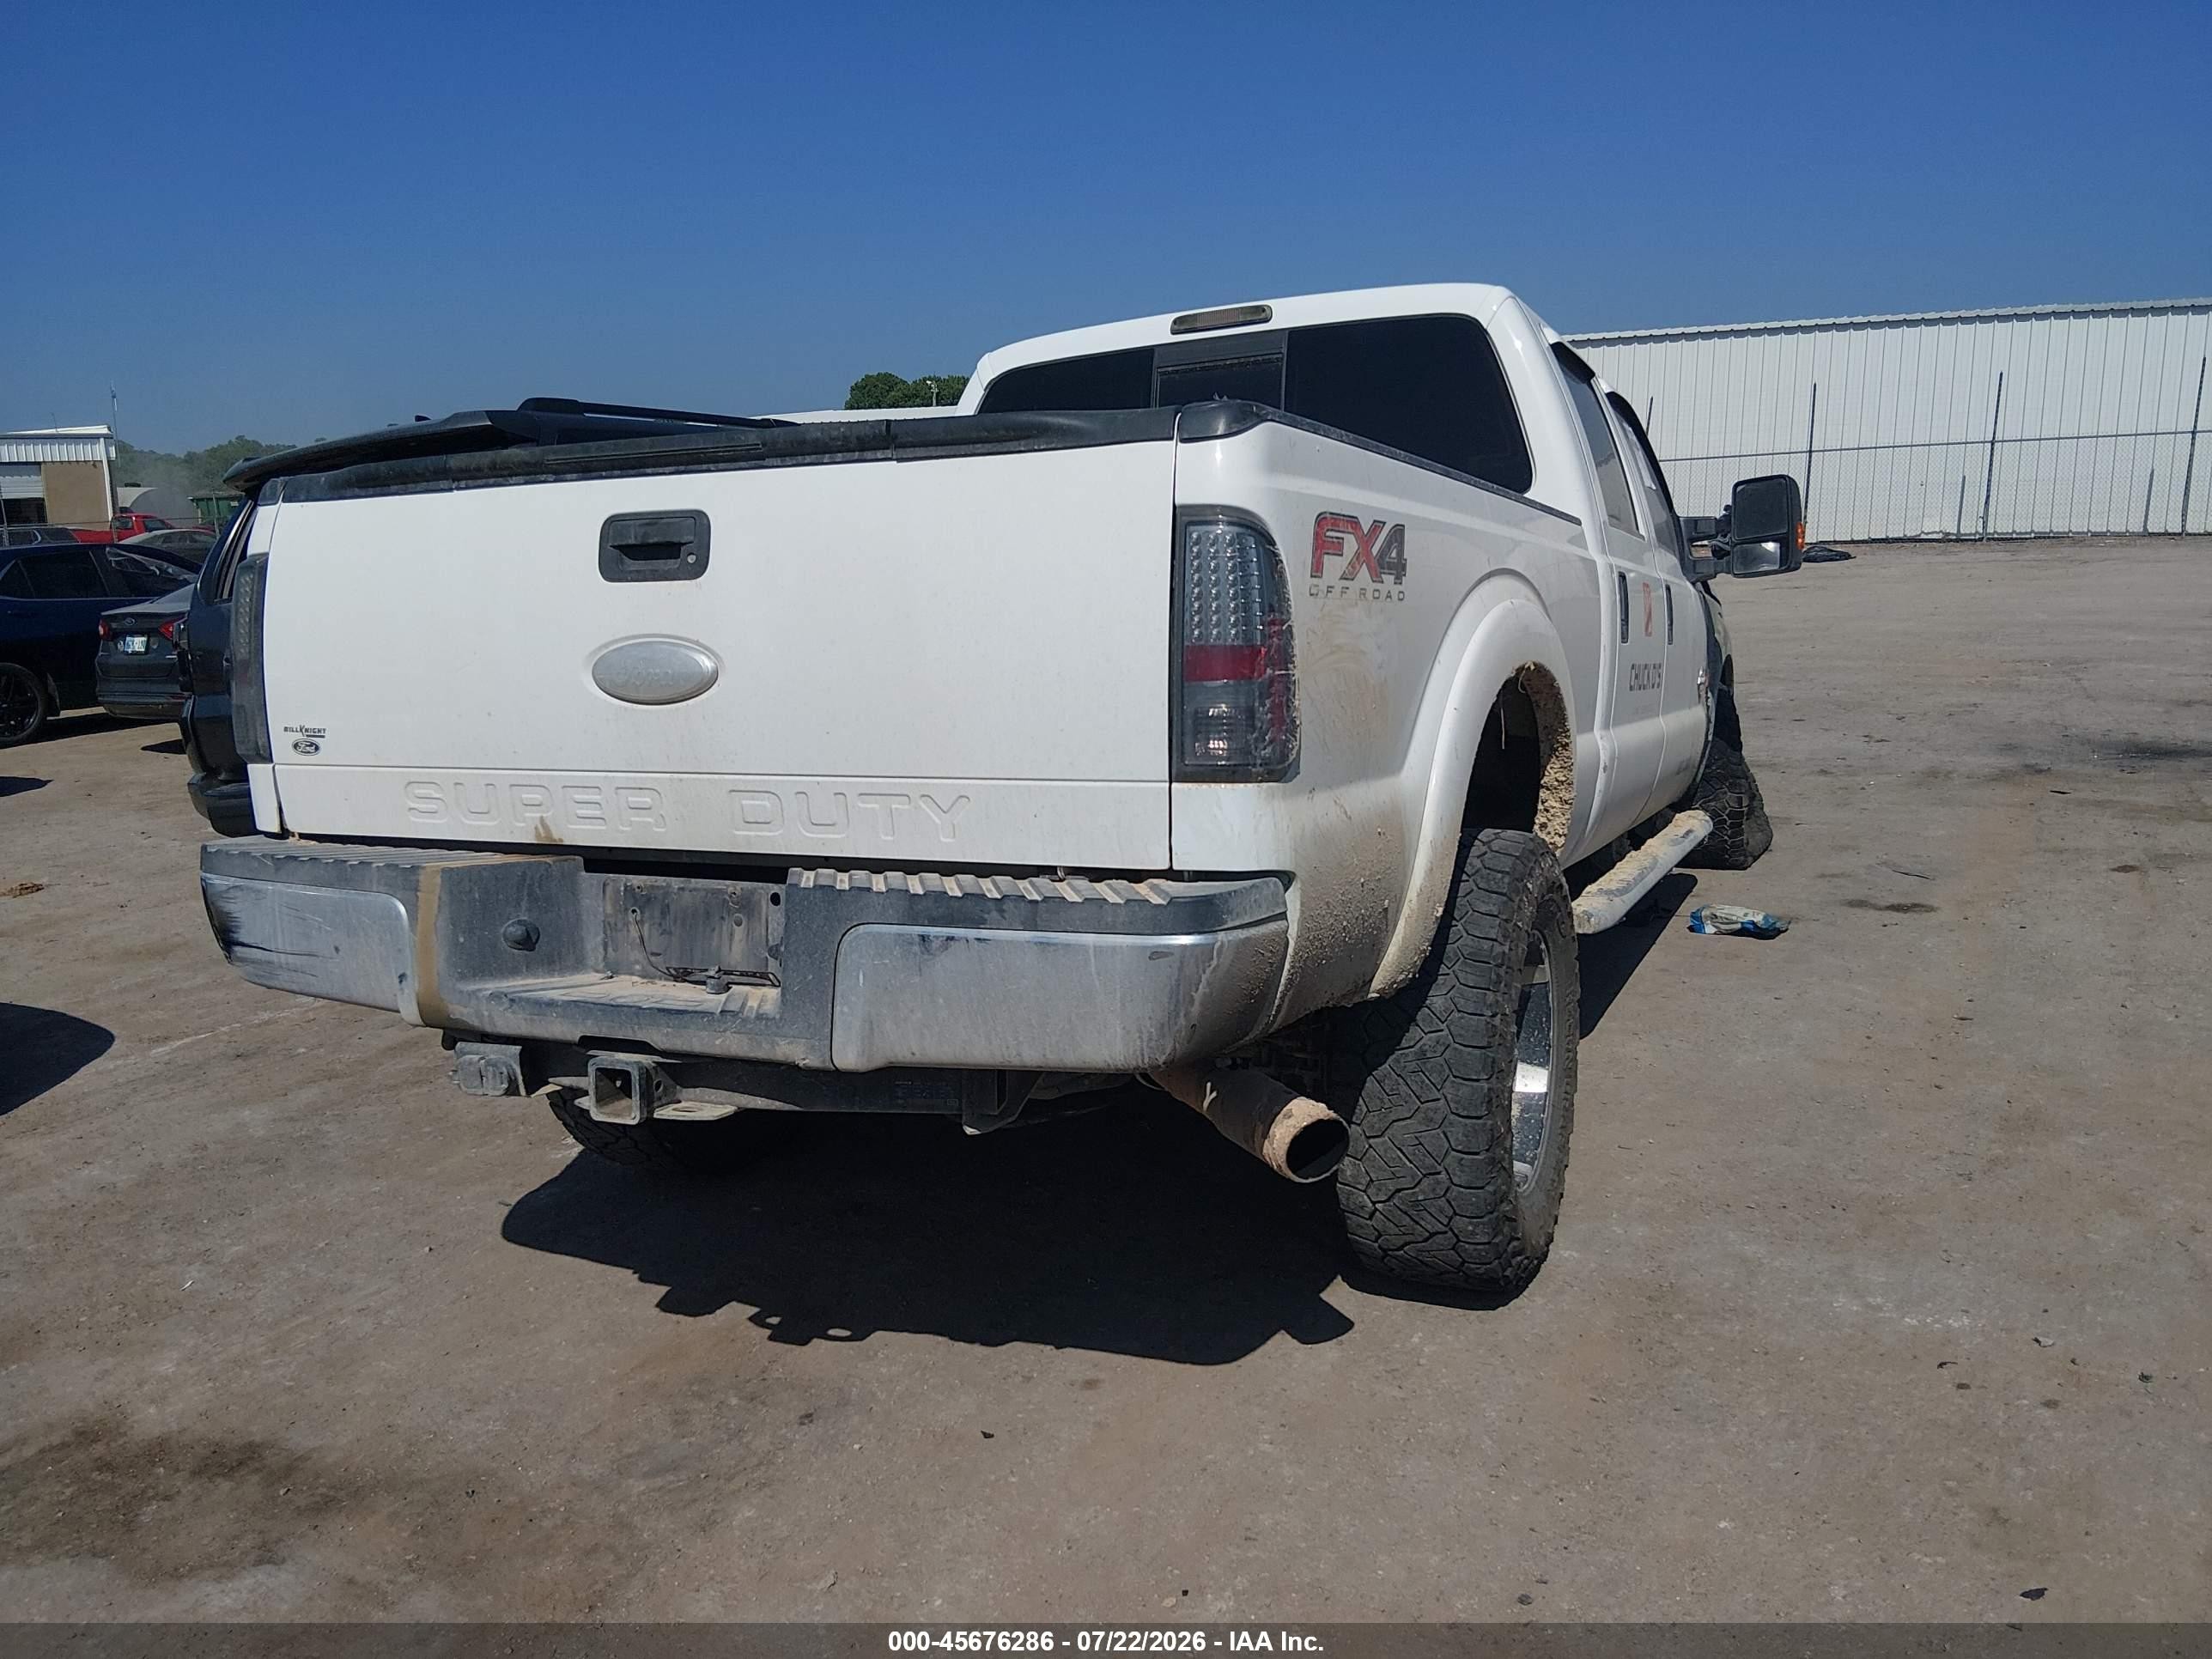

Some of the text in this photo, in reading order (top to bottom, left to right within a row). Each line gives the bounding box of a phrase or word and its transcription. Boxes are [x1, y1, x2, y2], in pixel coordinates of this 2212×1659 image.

[1310, 511, 1407, 586] FX4
[1309, 585, 1406, 602] OFF ROAD
[404, 781, 971, 842] SUPER DUTY
